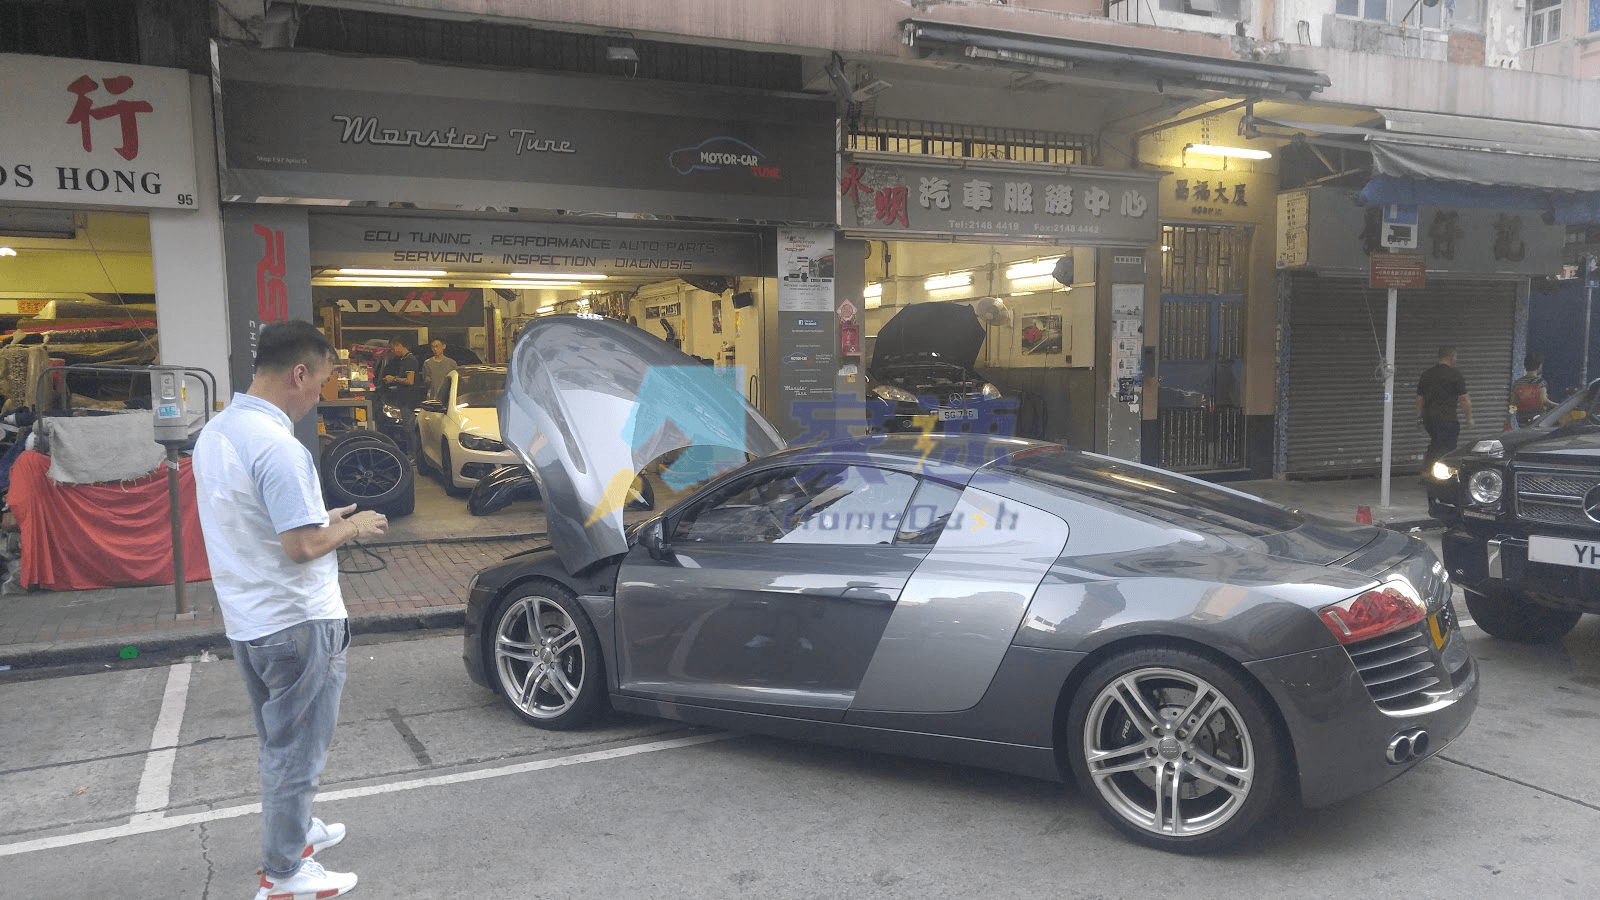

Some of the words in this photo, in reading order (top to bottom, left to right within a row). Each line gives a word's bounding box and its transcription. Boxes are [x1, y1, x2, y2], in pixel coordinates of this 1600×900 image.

[66, 74, 154, 161] 行
[333, 115, 498, 149] Monster
[509, 128, 576, 154] Tune
[700, 152, 758, 166] MOTOR-CAR
[55, 166, 162, 195] HONG
[177, 193, 194, 206] 95
[919, 176, 1149, 218] 汽車服務中心
[995, 221, 1019, 231] 4419
[1077, 224, 1099, 234] 4442
[363, 230, 400, 242] ECU
[409, 231, 472, 245] TUNING
[491, 234, 611, 250] PERFORMANCE
[619, 240, 660, 252] AUTO
[665, 241, 716, 254] PARTS
[393, 250, 484, 264] SERVICING
[502, 253, 597, 267] INSPECTION
[614, 257, 694, 270] DIAGNOSIS
[253, 223, 289, 323] RS
[335, 299, 457, 313] ADVAN
[957, 410, 974, 418] 76
